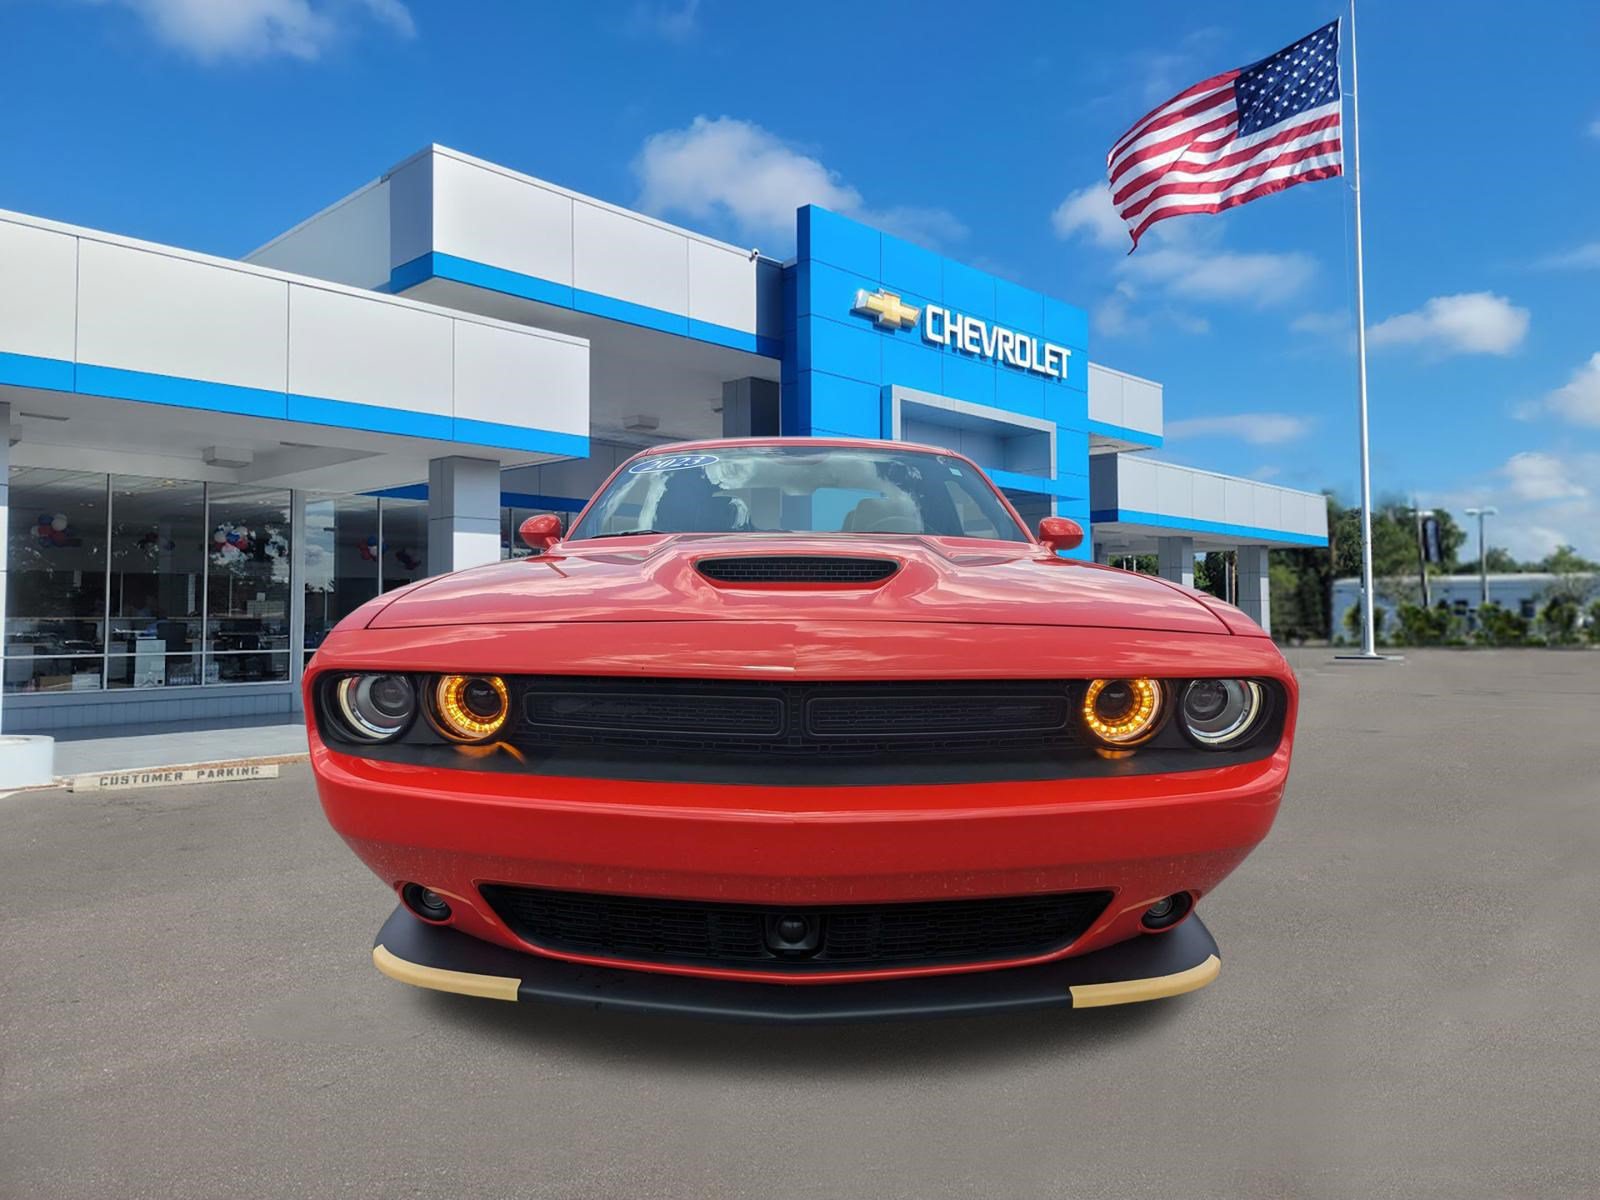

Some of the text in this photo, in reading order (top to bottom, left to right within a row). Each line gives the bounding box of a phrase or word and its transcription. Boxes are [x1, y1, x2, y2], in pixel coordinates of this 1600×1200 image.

[924, 304, 1072, 379] CHEVROLET
[643, 456, 706, 471] 2023
[100, 766, 260, 786] CUSTOMER PARKING
